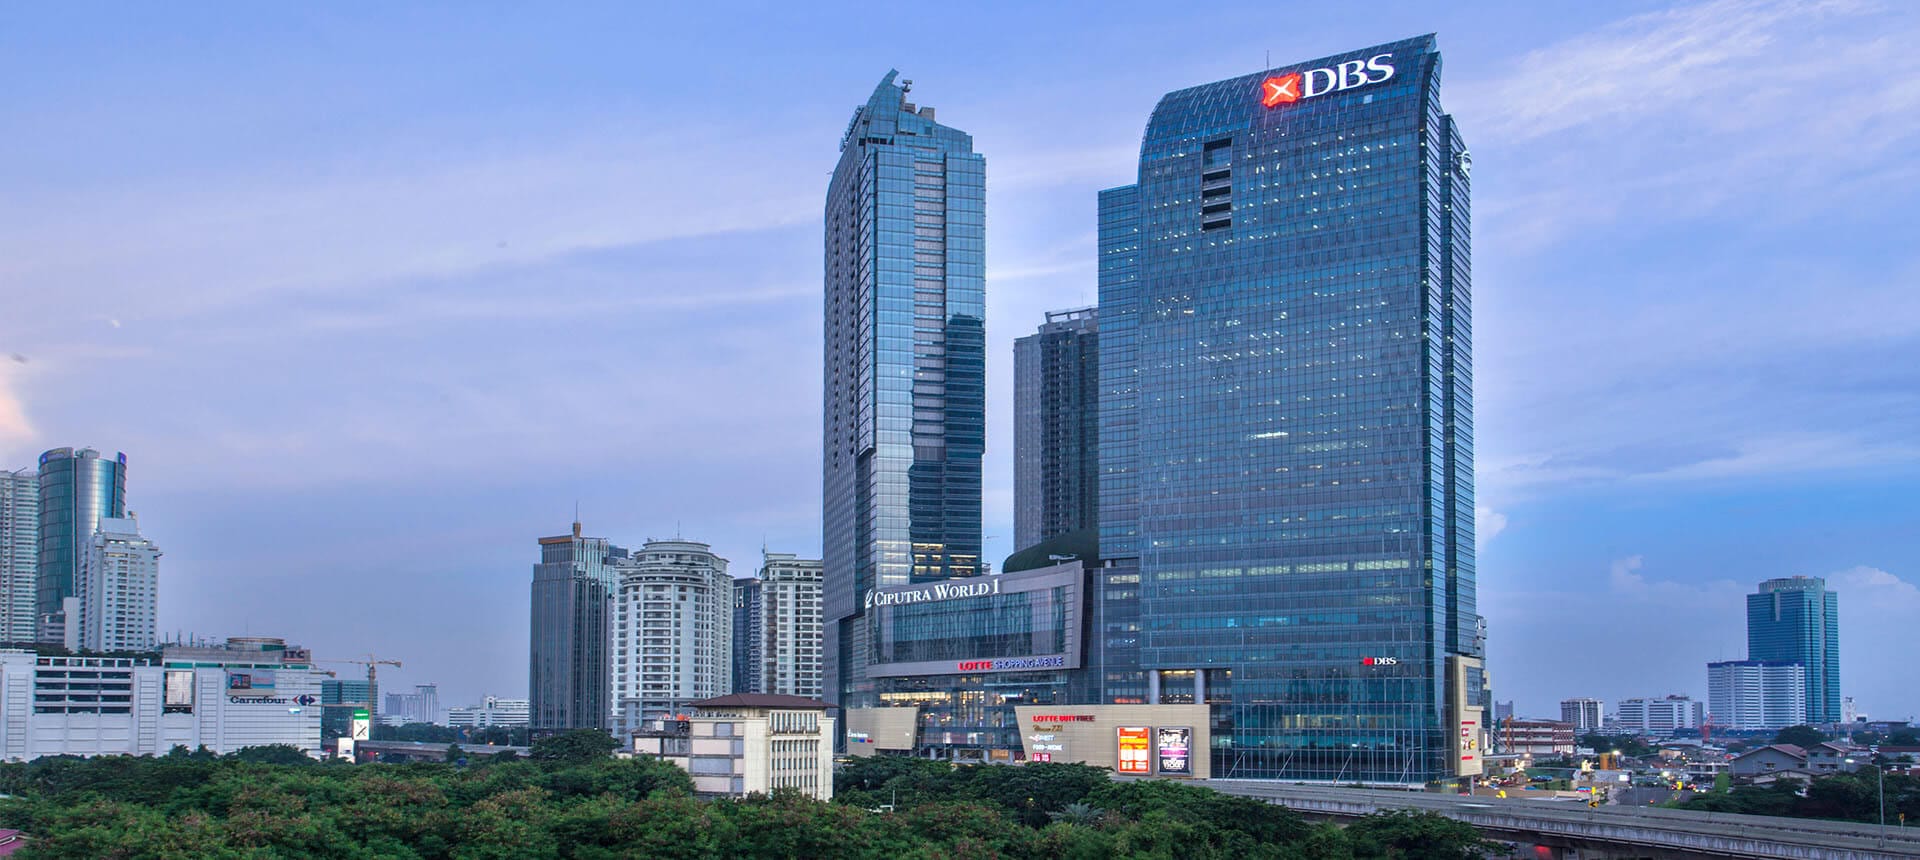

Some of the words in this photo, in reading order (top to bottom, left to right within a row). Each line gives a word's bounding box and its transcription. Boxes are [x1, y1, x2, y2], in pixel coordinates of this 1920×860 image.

[1303, 53, 1395, 99] DBS
[874, 589, 932, 607] CIPUTRA
[934, 583, 989, 600] WORLD
[993, 578, 1000, 594] 1
[283, 650, 305, 659] ITC
[1374, 656, 1397, 665] DBS
[958, 660, 992, 671] LOTTE
[994, 658, 1033, 670] SHOPPING
[1034, 656, 1064, 668] AVENUE
[230, 695, 287, 704] Carrefour
